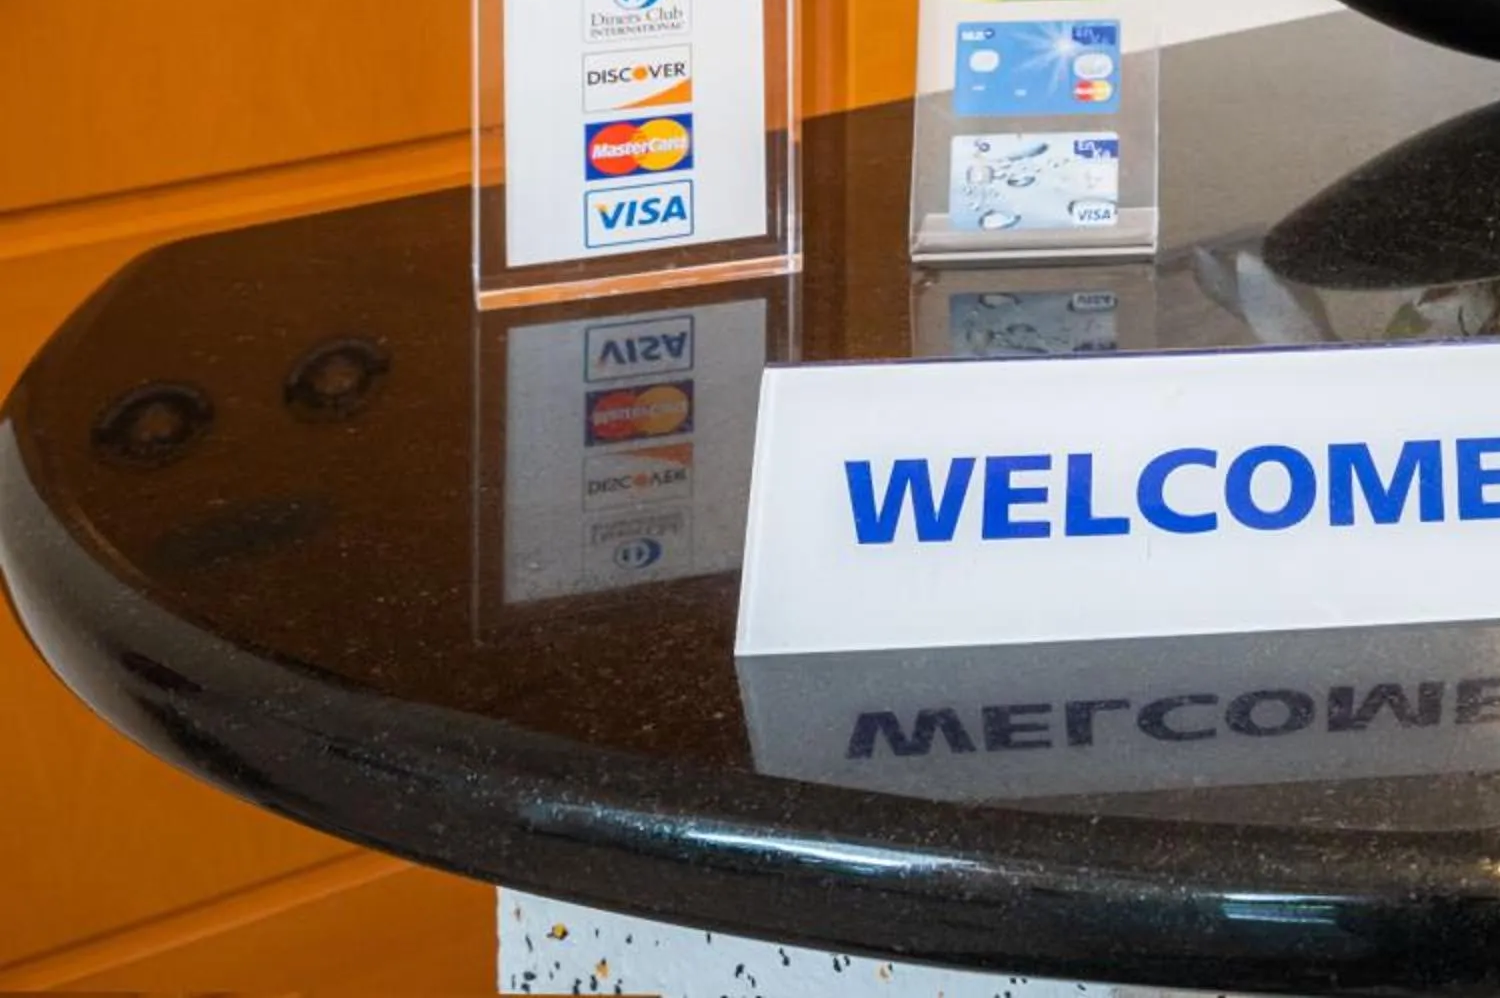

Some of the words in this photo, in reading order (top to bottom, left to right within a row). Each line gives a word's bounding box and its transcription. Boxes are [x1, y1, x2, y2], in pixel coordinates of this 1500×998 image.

[591, 11, 641, 27] Diners
[645, 2, 684, 22] Club
[586, 62, 687, 86] DISCOVER
[591, 137, 689, 160] MasterCard
[594, 195, 688, 230] VISA
[1077, 207, 1112, 222] VISA
